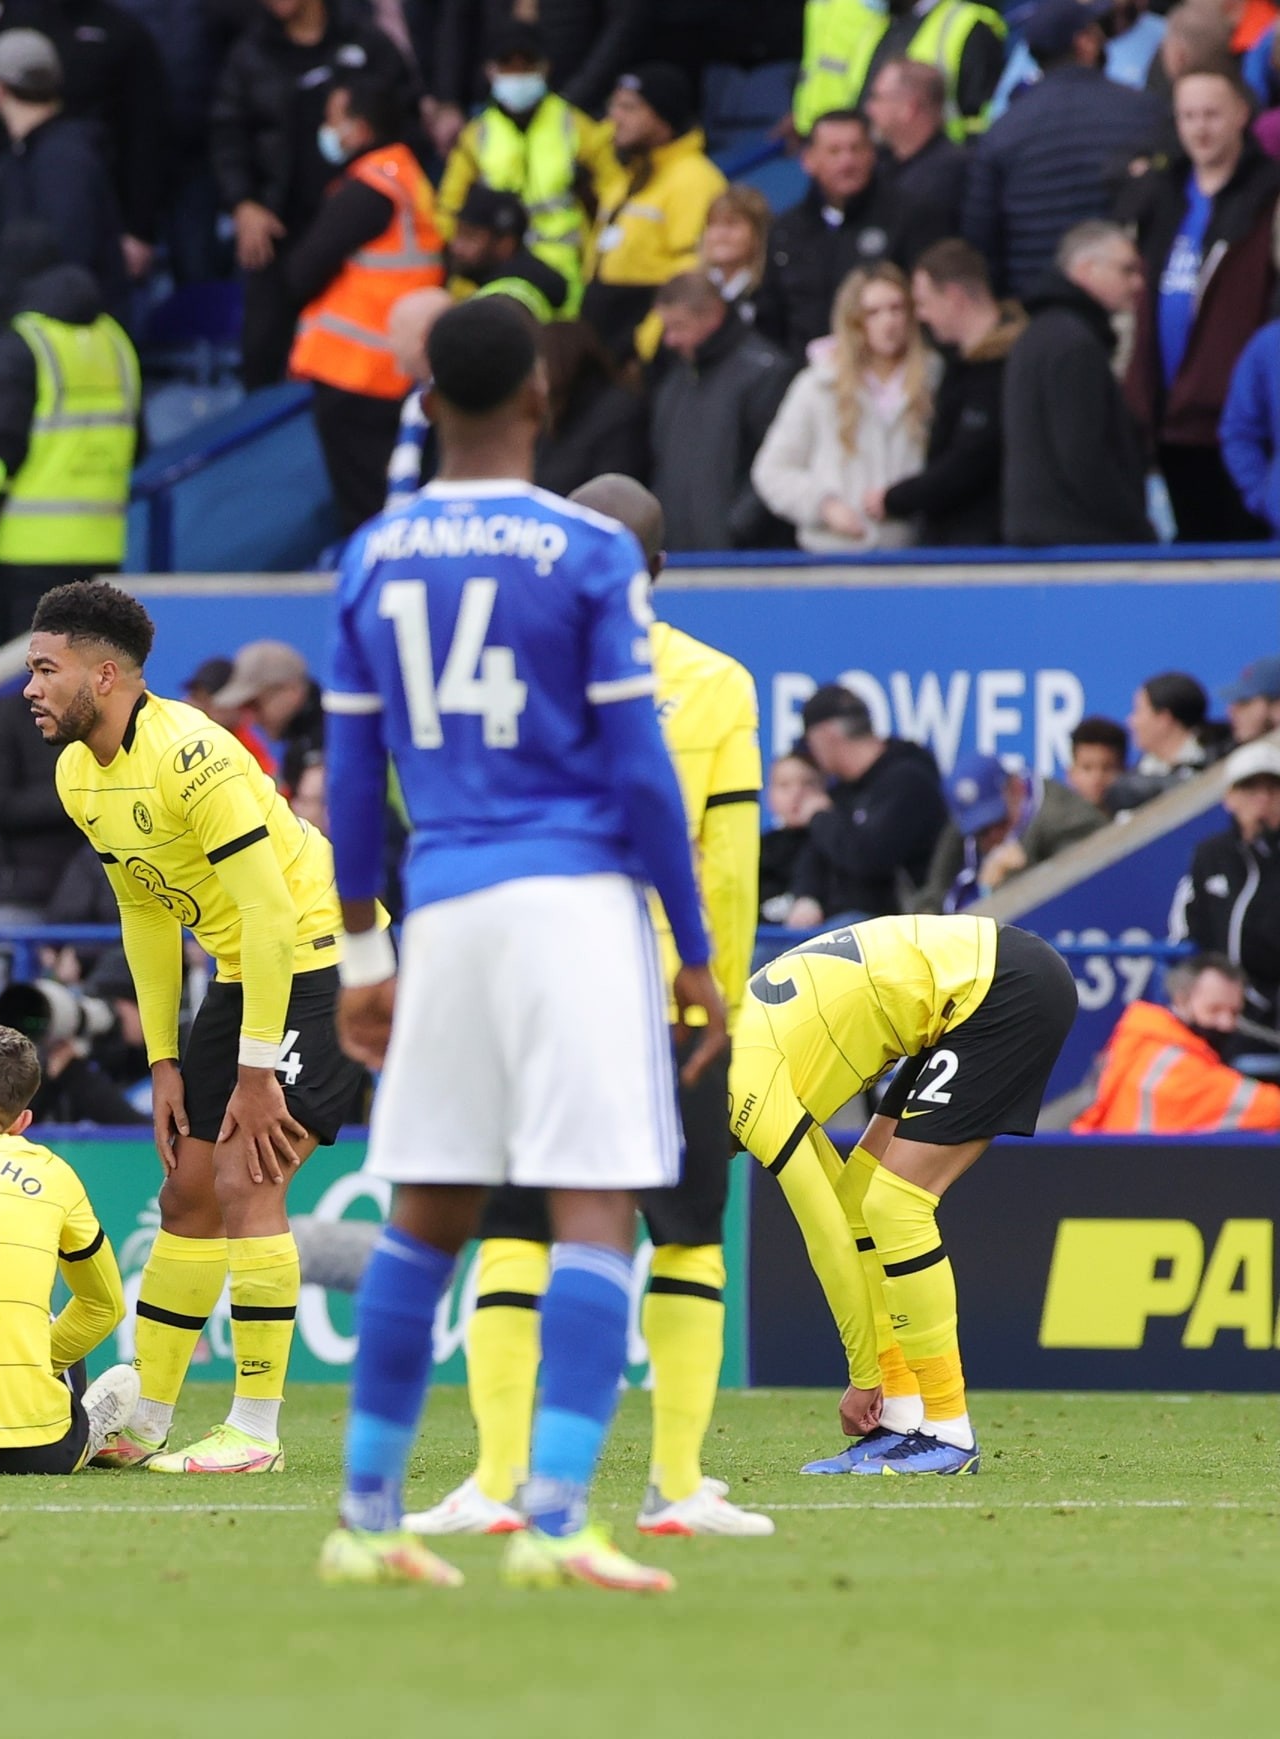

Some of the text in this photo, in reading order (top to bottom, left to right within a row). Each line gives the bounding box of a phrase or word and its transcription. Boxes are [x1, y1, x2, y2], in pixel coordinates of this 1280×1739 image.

[378, 577, 529, 750] 14
[907, 1049, 959, 1104] 2
[1038, 1217, 1280, 1350] PA
[890, 1314, 909, 1322] FC
[242, 1360, 271, 1369] CFC
